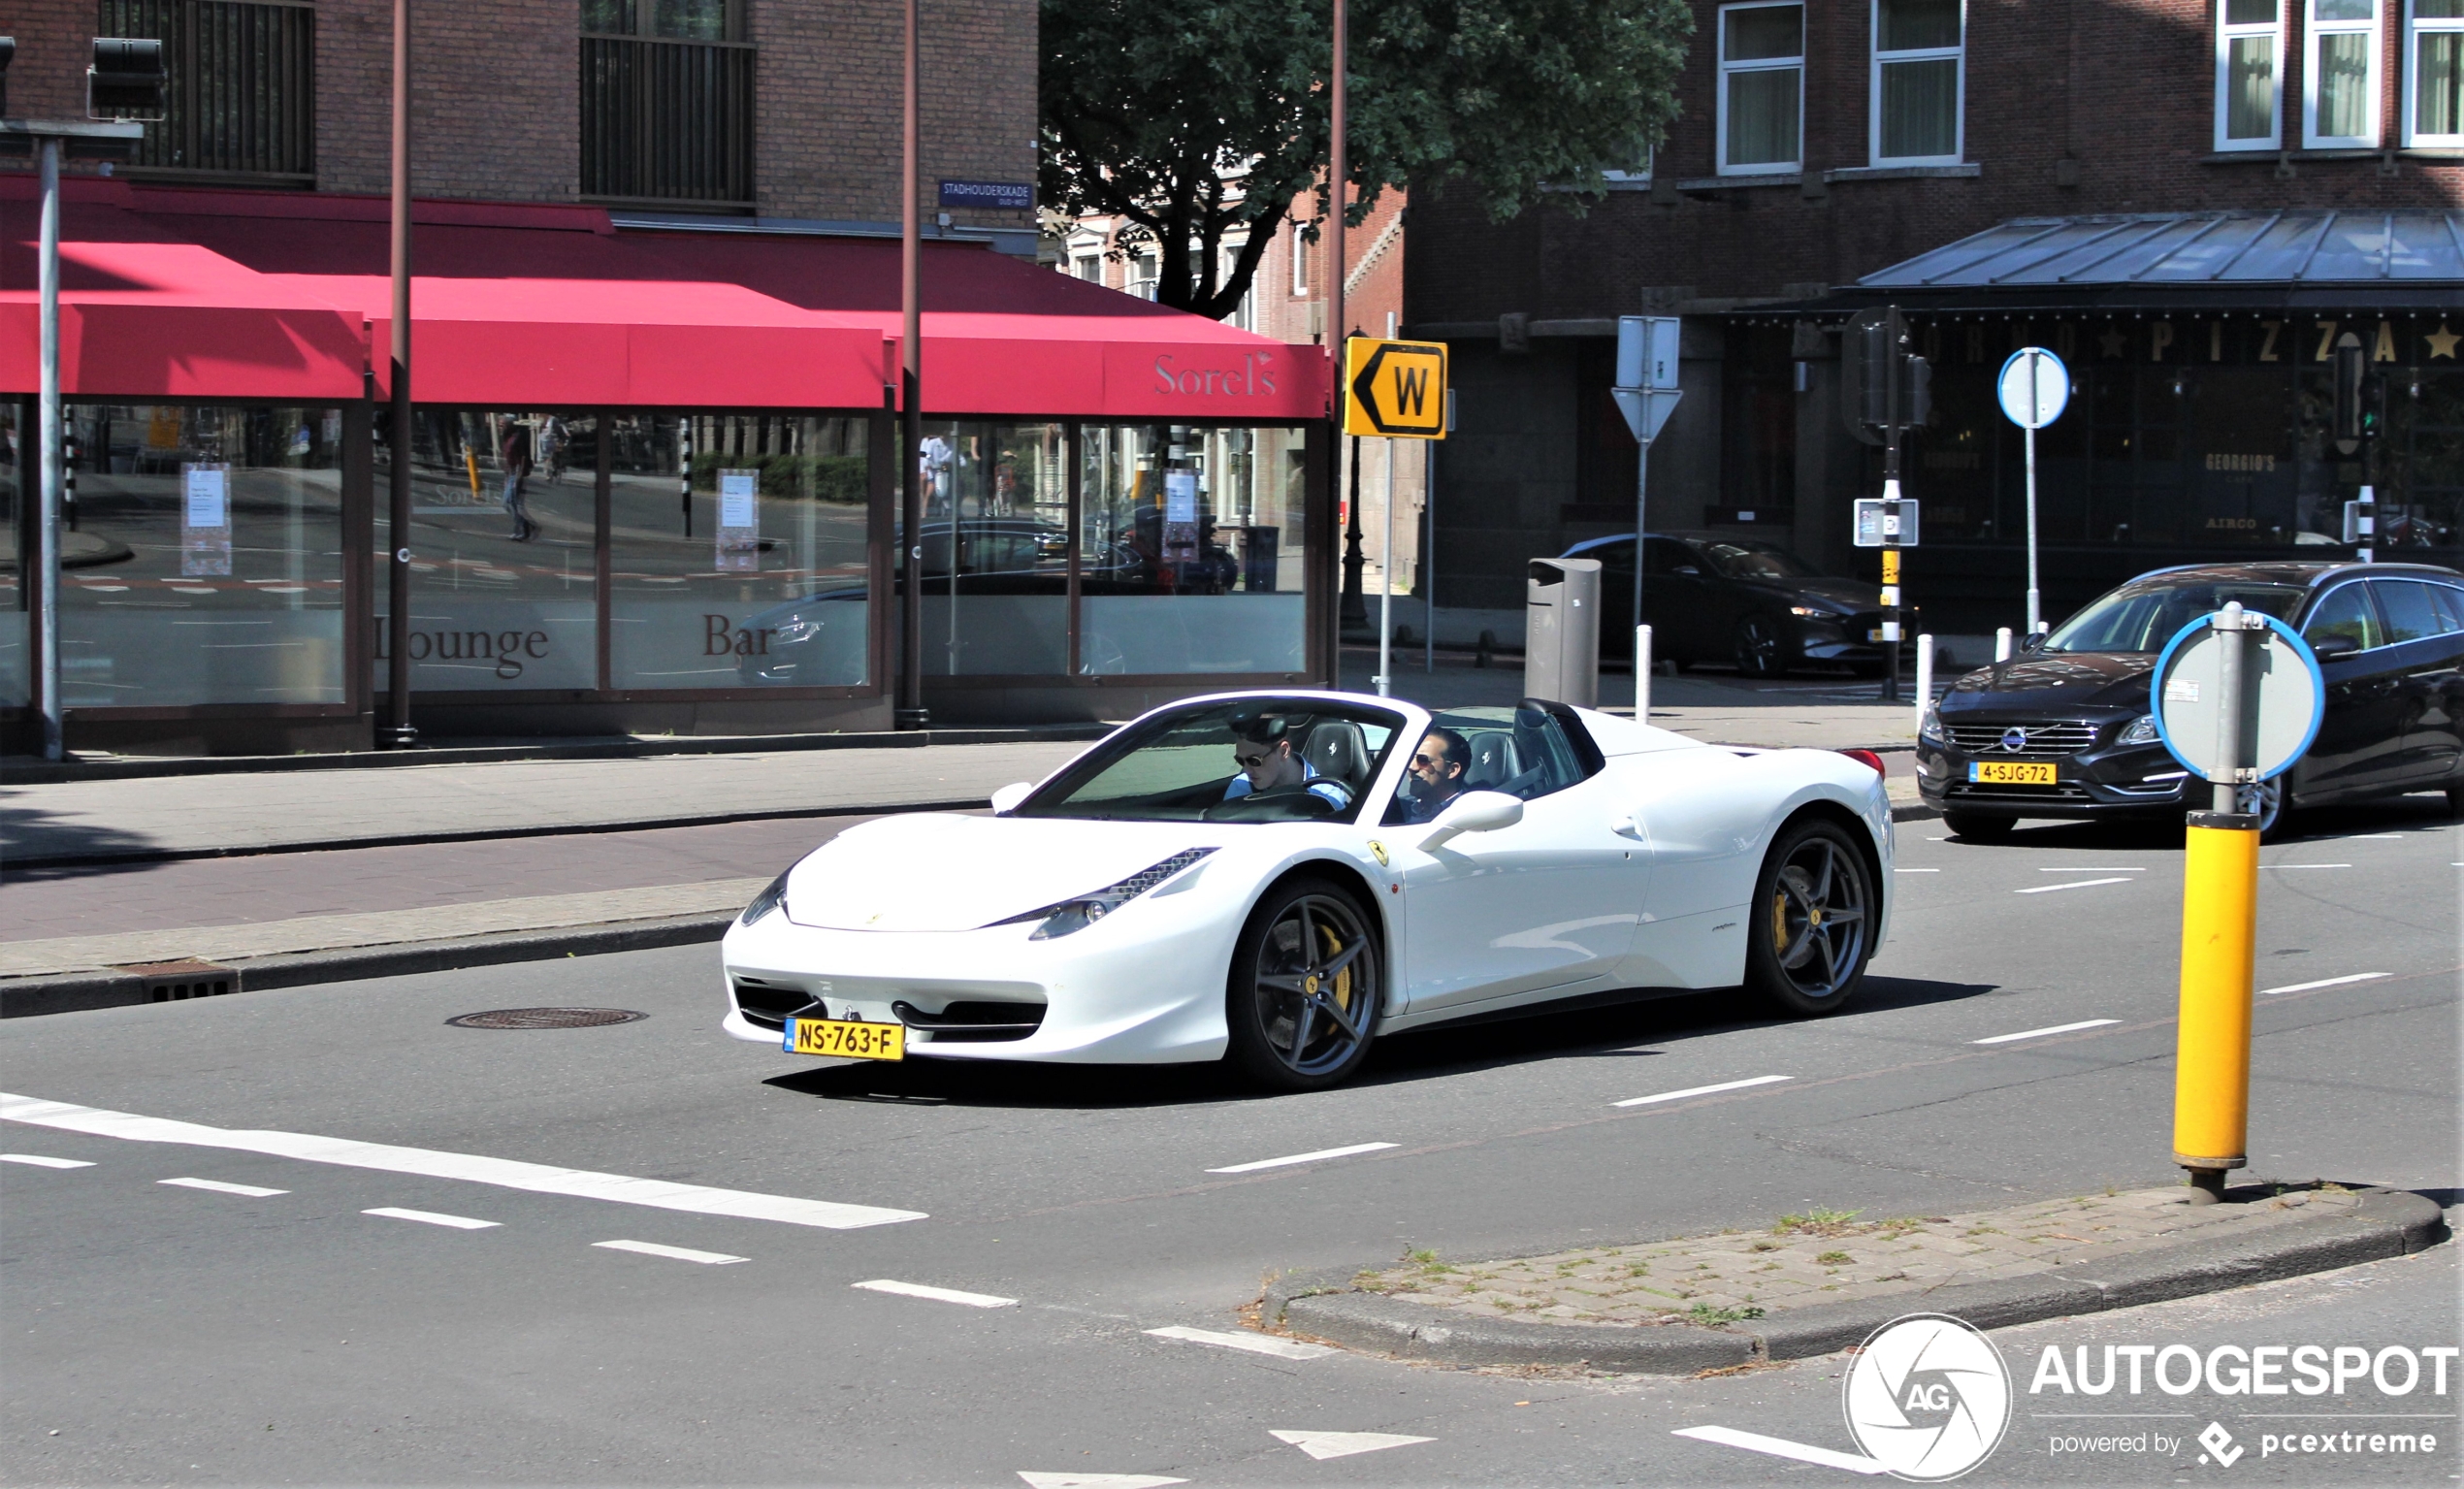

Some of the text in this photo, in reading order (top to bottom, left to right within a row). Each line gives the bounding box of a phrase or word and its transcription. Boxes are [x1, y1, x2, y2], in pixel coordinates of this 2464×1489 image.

[944, 183, 1028, 197] STADHOUDERSKADE
[1924, 320, 2397, 364] ORNO PIZZA
[1154, 350, 1277, 396] Sorel's
[1394, 366, 1428, 416] W
[2205, 453, 2275, 471] GEORGIO'S
[2206, 518, 2256, 529] AIRCO
[373, 616, 549, 679] Lounge
[702, 614, 777, 657] Bar
[1984, 765, 2048, 781] 4-SJG-72
[786, 1023, 892, 1054] NL NS-763-F
